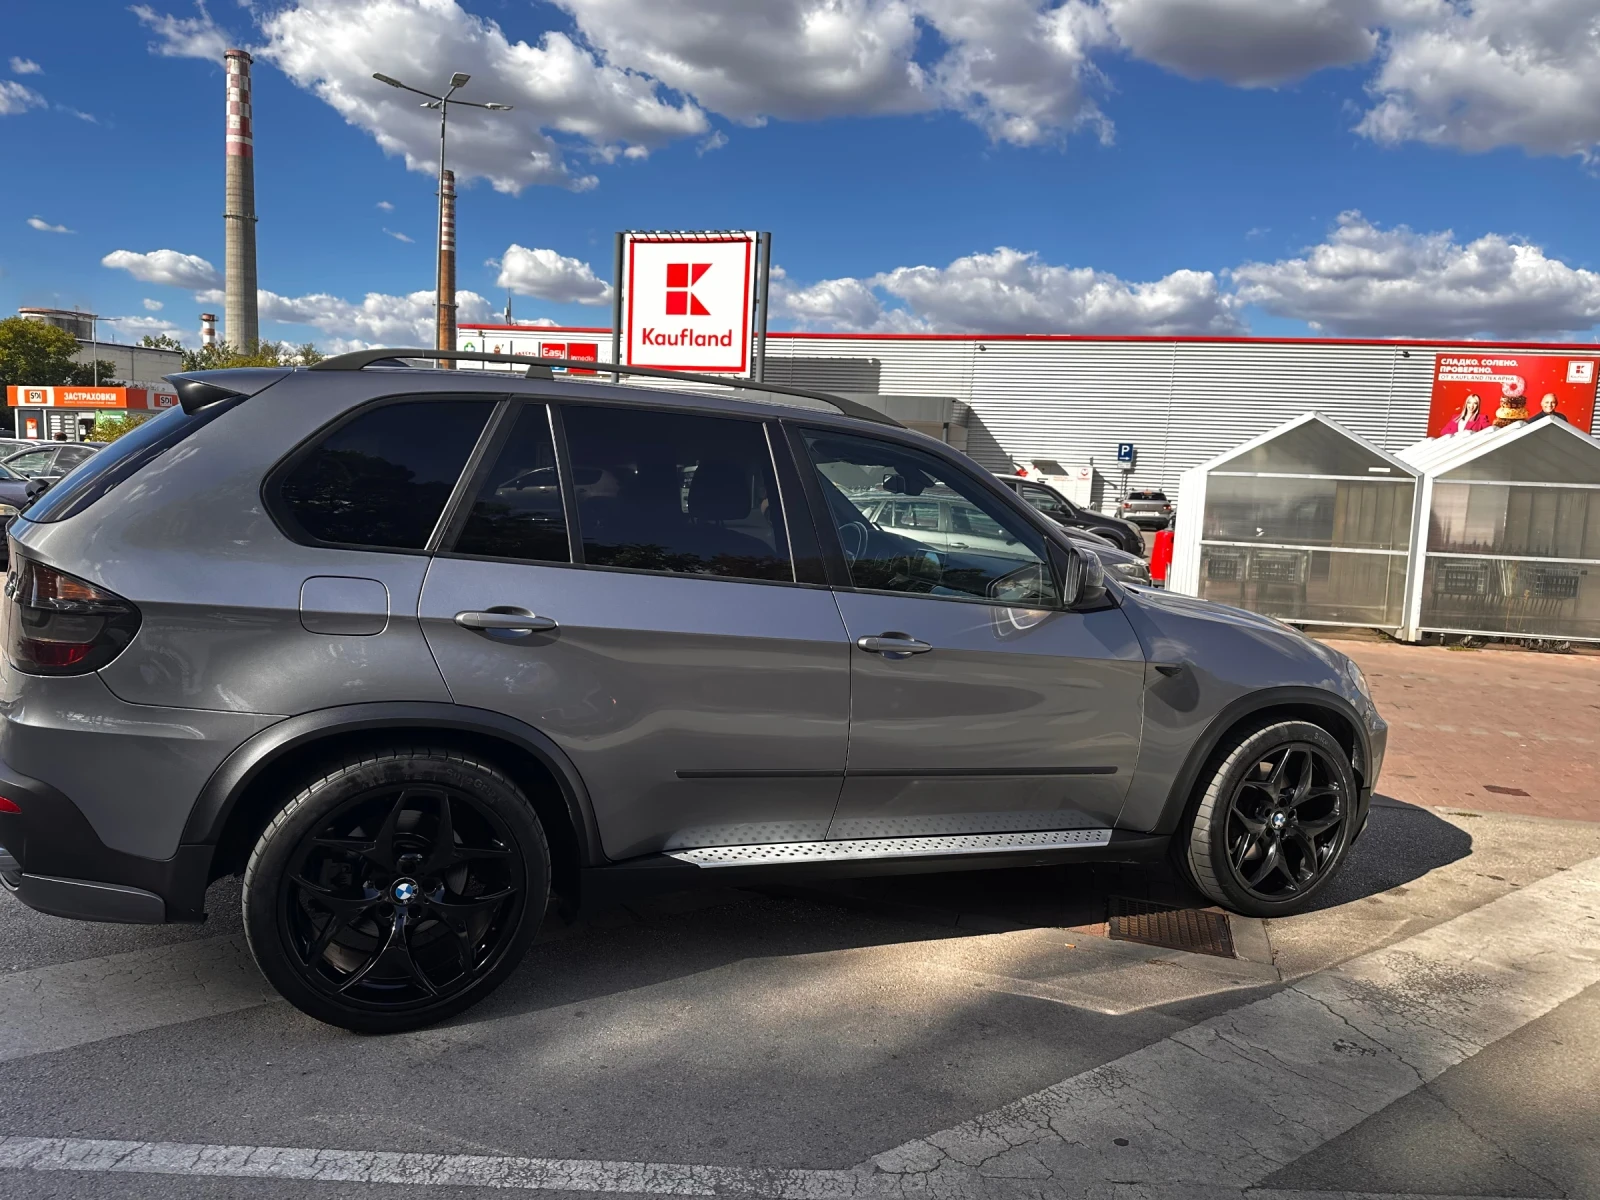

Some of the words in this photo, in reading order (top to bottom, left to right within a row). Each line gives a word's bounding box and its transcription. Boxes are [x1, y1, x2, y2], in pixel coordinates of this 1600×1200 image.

[642, 327, 732, 347] Kaufland
[543, 348, 564, 359] Easy
[571, 354, 594, 362] inmedio
[1440, 358, 1479, 366] СЛАДКО.
[1481, 358, 1518, 367] СОЛЕНО.
[1440, 366, 1493, 374] ПРОВЕРЕНО.
[64, 391, 116, 401] ЗАСТРАХОВКИ
[1121, 445, 1130, 456] P
